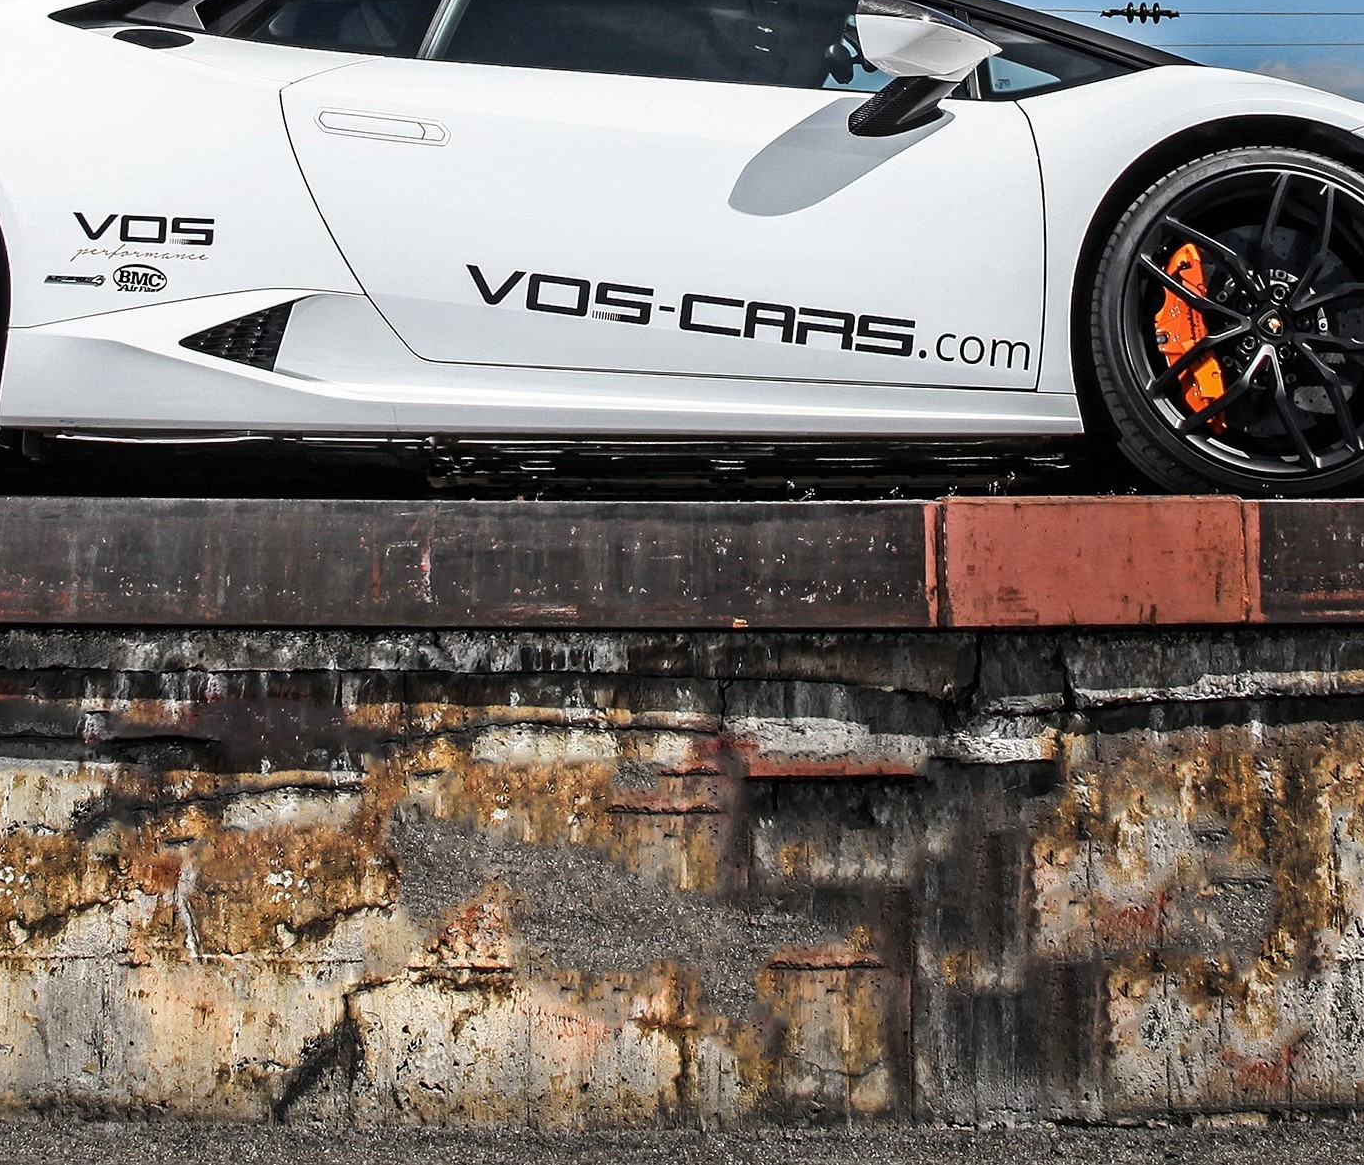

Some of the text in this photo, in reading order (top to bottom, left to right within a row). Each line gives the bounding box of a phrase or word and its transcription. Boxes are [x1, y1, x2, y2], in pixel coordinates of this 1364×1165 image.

[72, 211, 215, 246] VOS
[70, 243, 209, 262] performance
[118, 270, 164, 288] BMC
[465, 263, 1031, 371] VOS-CARS.com
